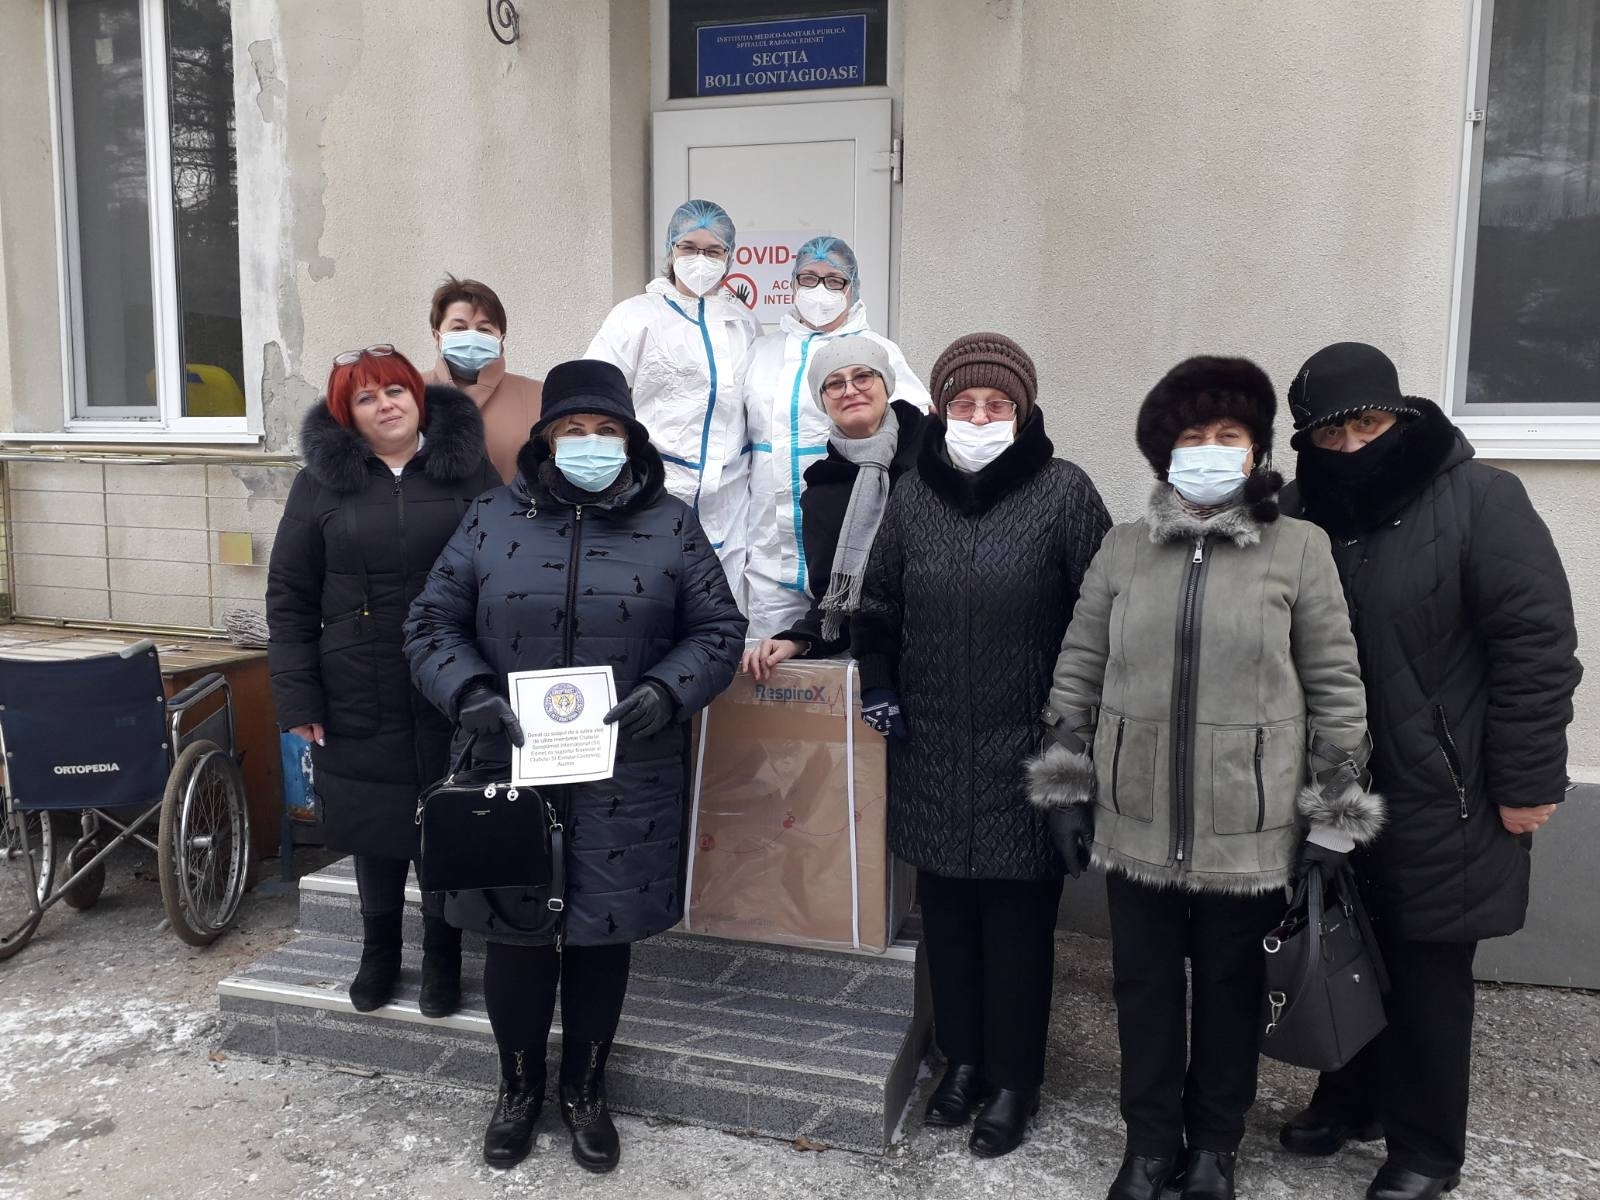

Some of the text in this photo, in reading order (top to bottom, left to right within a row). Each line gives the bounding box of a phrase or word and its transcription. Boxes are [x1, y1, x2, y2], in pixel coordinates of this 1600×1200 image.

[752, 50, 808, 67] SECȚIA
[704, 65, 858, 88] BOLI CONTAGIOASE
[736, 246, 797, 265] OVID-
[755, 684, 826, 702] RespiroX
[53, 762, 120, 775] ORTOPEDIA
